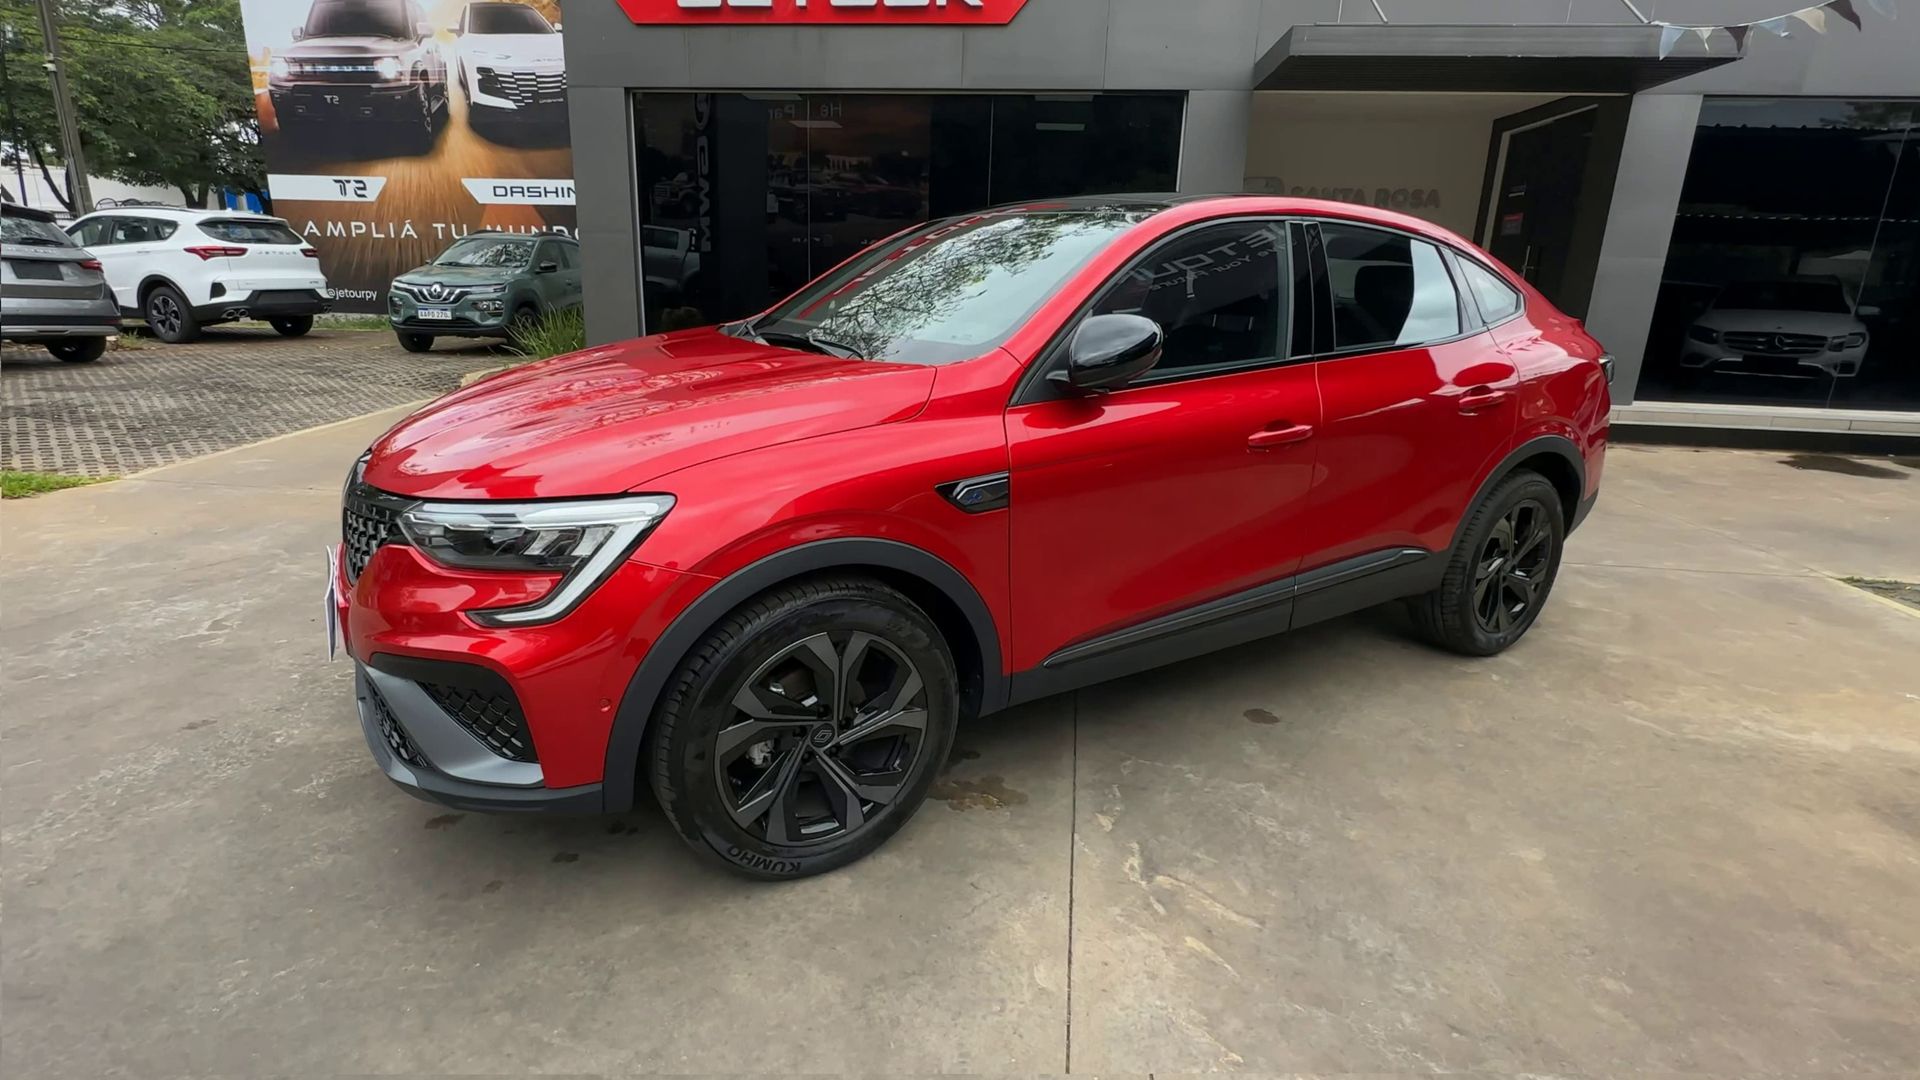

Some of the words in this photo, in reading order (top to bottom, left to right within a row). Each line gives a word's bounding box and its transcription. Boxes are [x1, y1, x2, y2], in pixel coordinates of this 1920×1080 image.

[324, 94, 340, 105] T2
[332, 179, 368, 198] T2
[303, 219, 418, 239] AMPLIÁ
[432, 223, 468, 239] TU
[327, 288, 378, 301] @jetourpy
[727, 845, 801, 873] KUMHO
